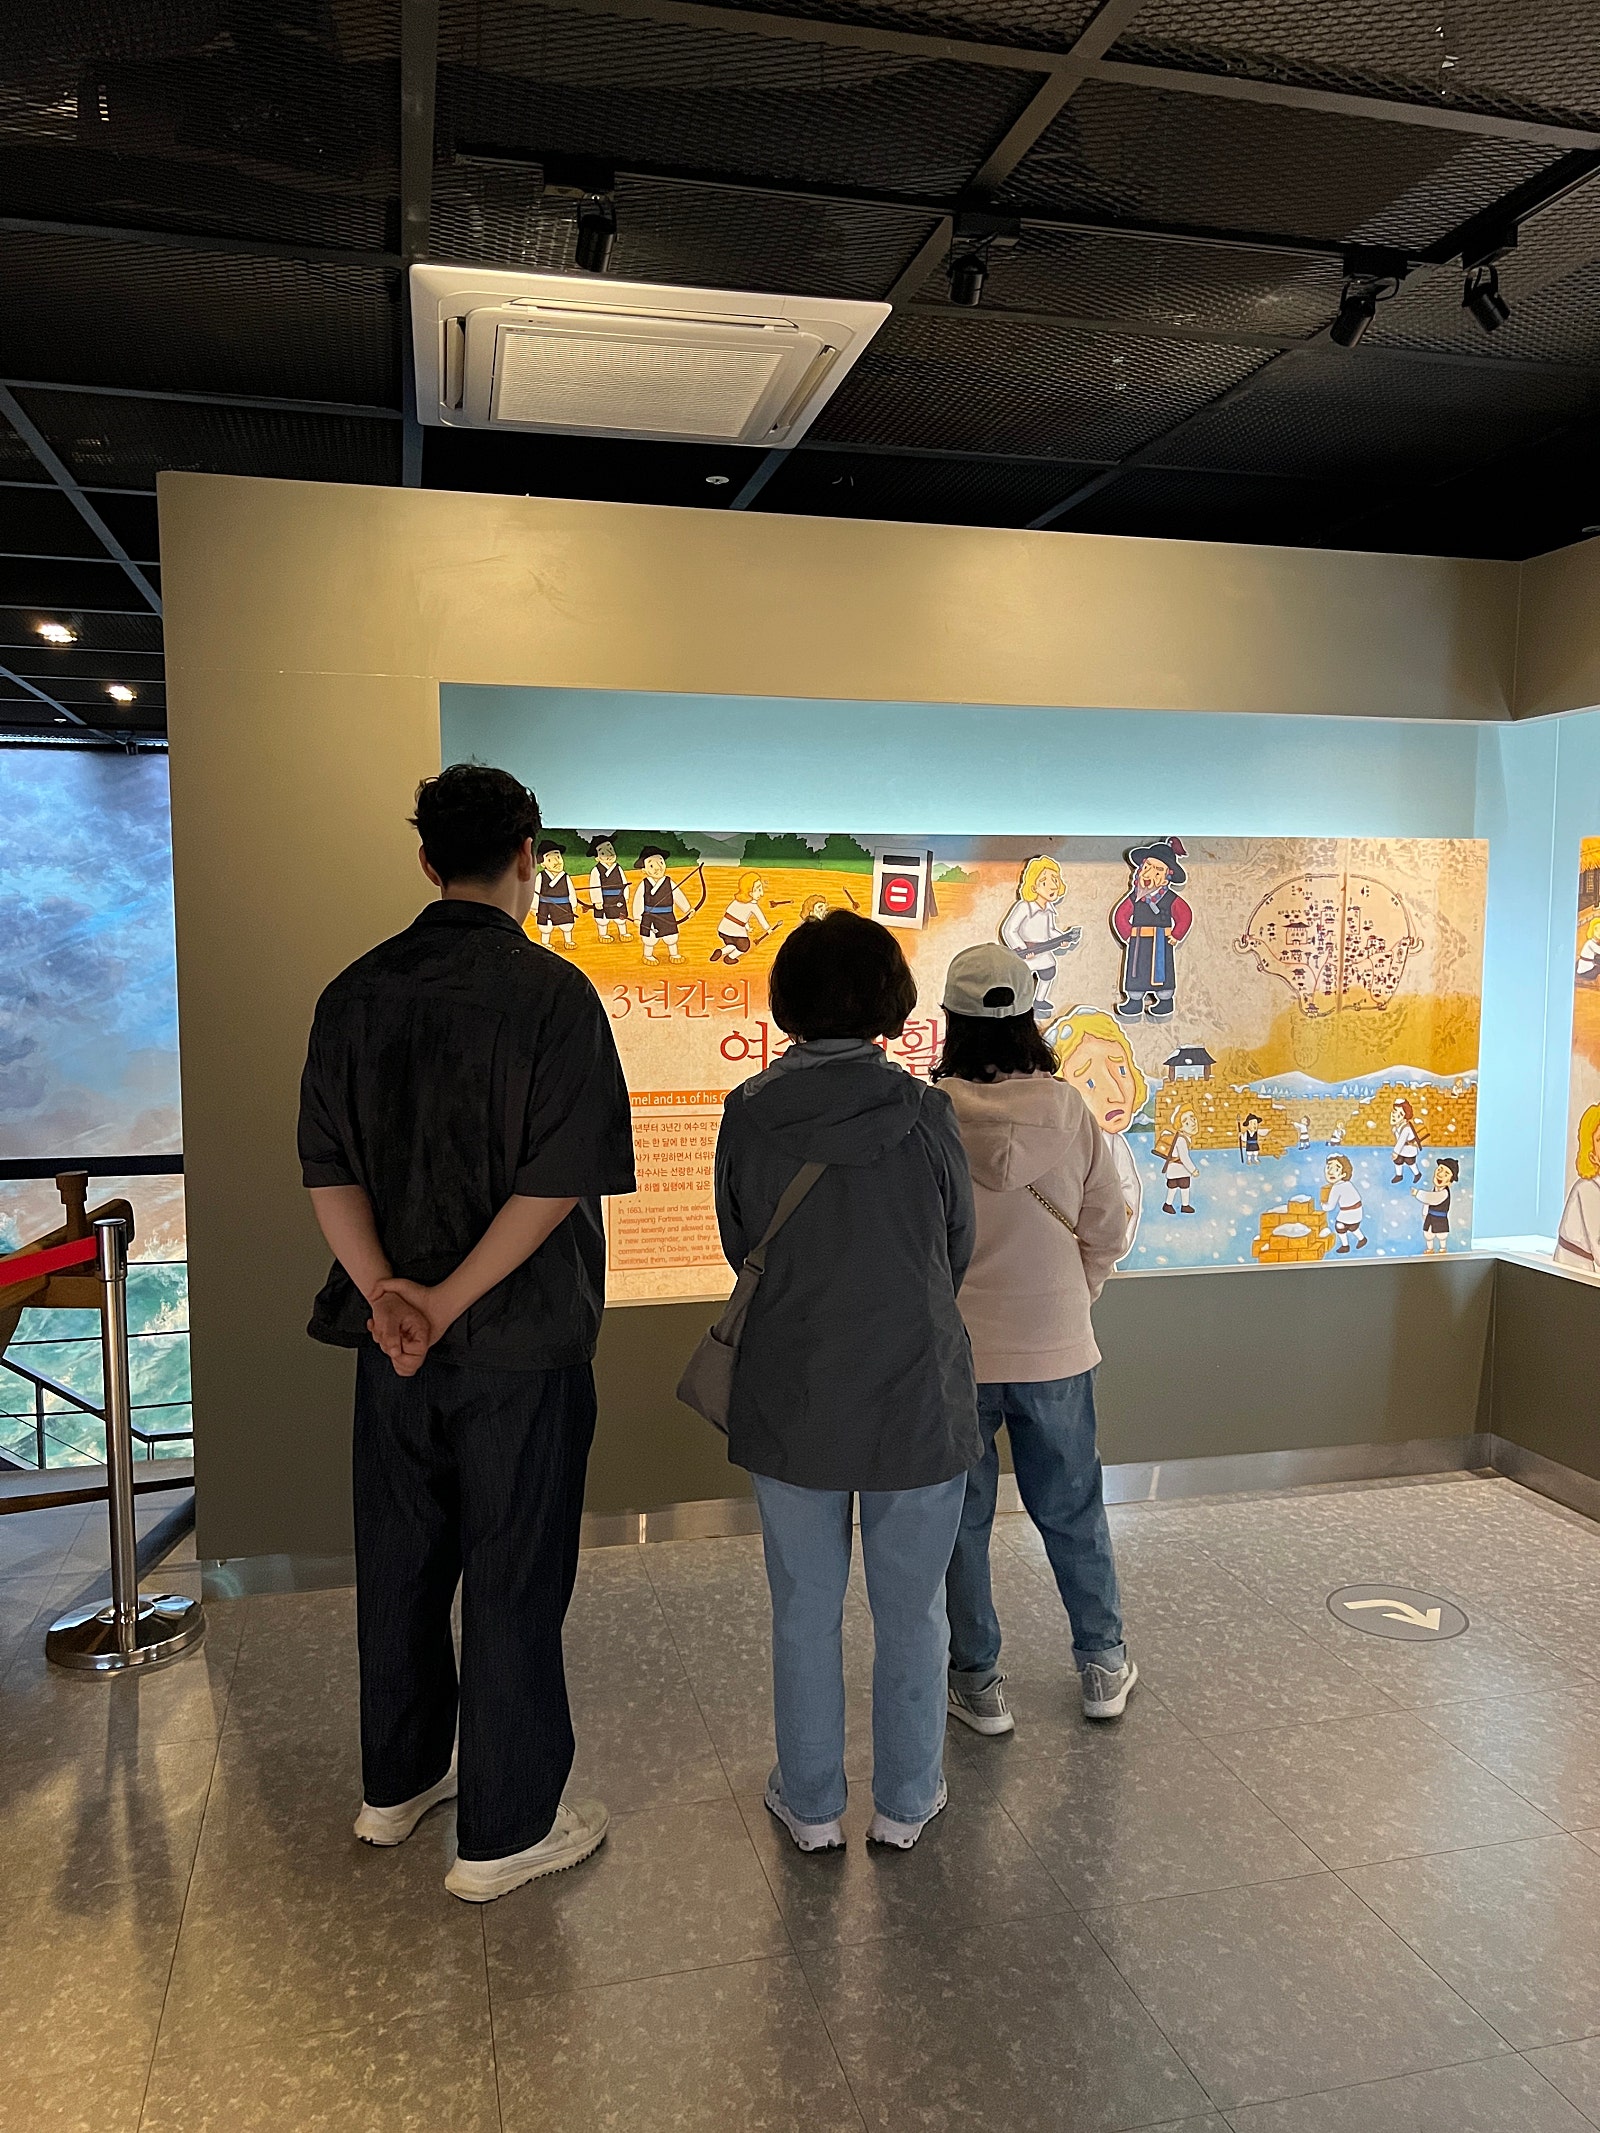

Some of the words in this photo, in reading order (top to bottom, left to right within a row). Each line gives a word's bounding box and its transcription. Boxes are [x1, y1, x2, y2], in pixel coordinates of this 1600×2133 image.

[611, 979, 750, 1019] 3년간의
[720, 1020, 790, 1071] 여
[631, 1092, 651, 1105] mel
[653, 1092, 673, 1105] and
[675, 1095, 687, 1104] 11
[689, 1092, 701, 1104] of
[703, 1091, 718, 1103] his
[632, 1123, 659, 1133] 년부터
[661, 1122, 681, 1133] 3년간
[684, 1121, 708, 1132] 여수의
[634, 1137, 650, 1148] 에는
[652, 1137, 660, 1148] 한
[680, 1136, 688, 1147] 한
[696, 1165, 715, 1176] 사람
